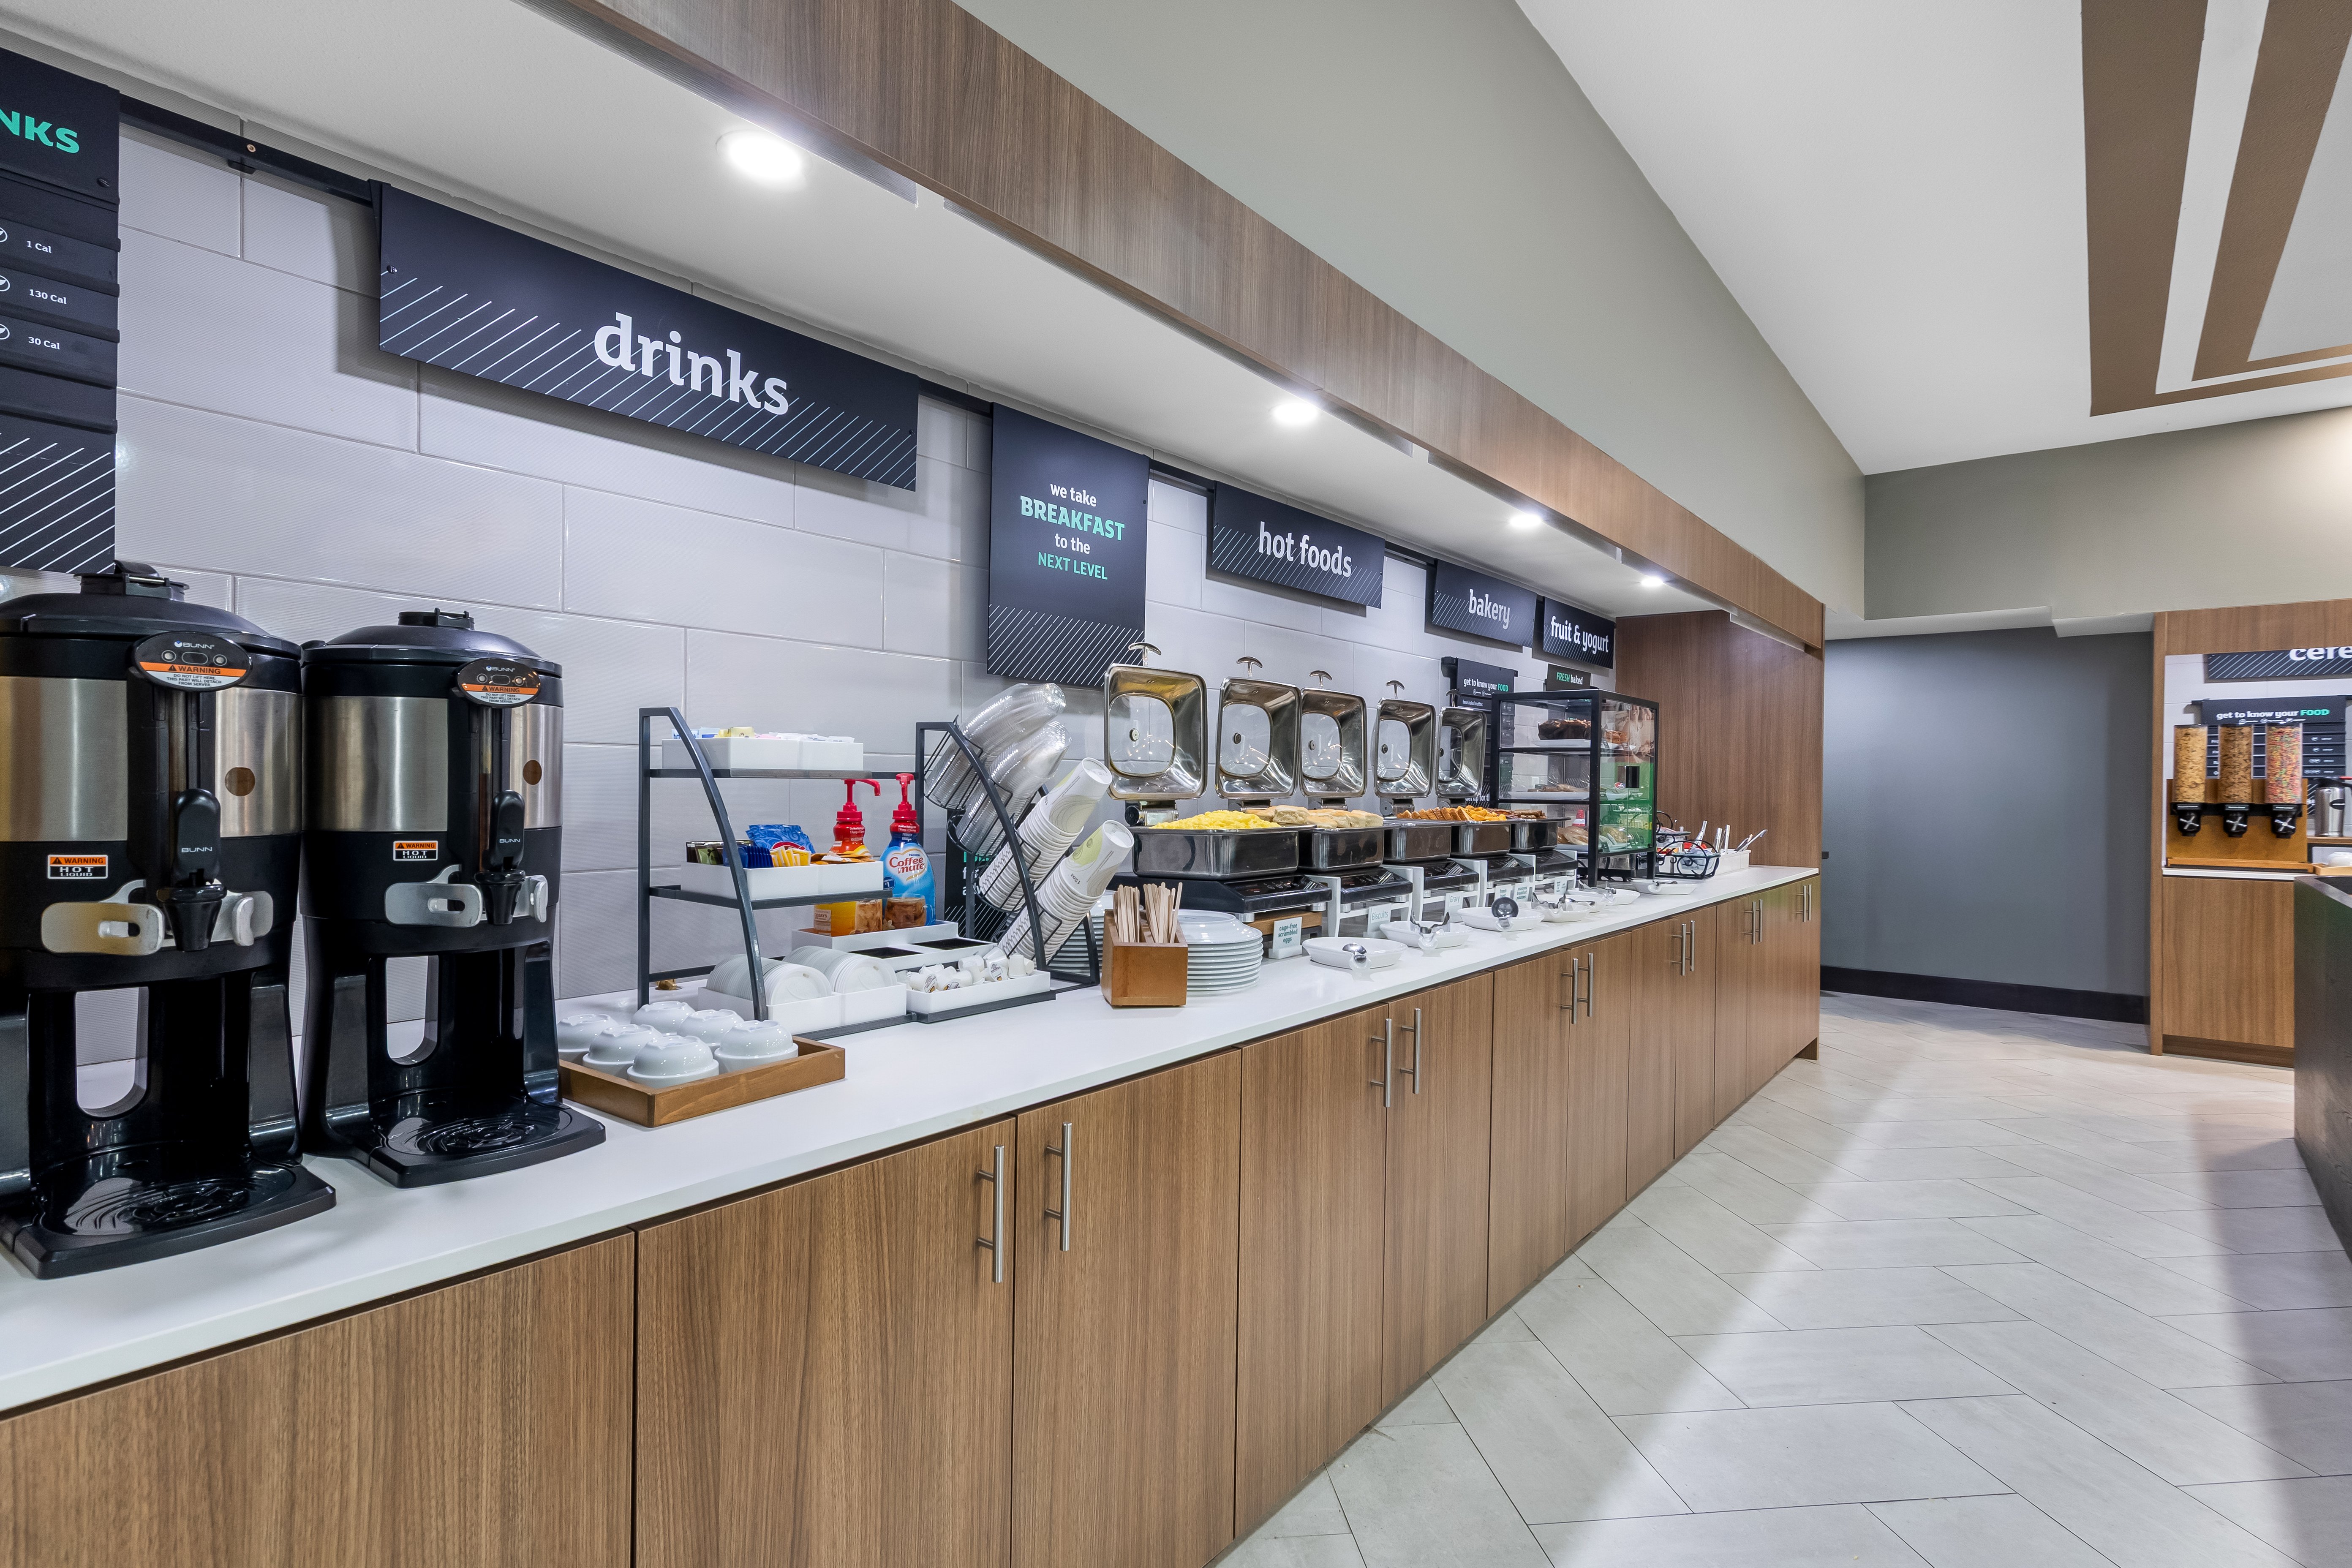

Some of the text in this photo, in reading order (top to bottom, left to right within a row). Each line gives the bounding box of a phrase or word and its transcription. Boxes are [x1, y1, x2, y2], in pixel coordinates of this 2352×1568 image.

[35, 242, 52, 253] Cal
[29, 289, 67, 305] 130 Cal
[28, 337, 60, 350] 30 Cal
[594, 312, 789, 415] drinks
[1050, 483, 1097, 507] we take
[1020, 495, 1125, 541] BREAKFAST
[1055, 533, 1090, 554] to the
[1259, 521, 1352, 577] hot foods
[1038, 551, 1108, 580] NEXT LEVEL
[1469, 588, 1510, 629] bakery
[1551, 616, 1609, 654] fruit & yogurt
[178, 665, 221, 675] WARNING
[1556, 672, 1583, 685] FRESH baked
[1477, 679, 1488, 688] know
[1488, 683, 1497, 691] your
[1498, 683, 1508, 692] FOOD
[889, 856, 923, 868] Coffee
[898, 863, 924, 874] mate
[1372, 910, 1388, 920] Biscuits
[1278, 929, 1298, 938] scrambled
[1279, 923, 1298, 931] cage-free
